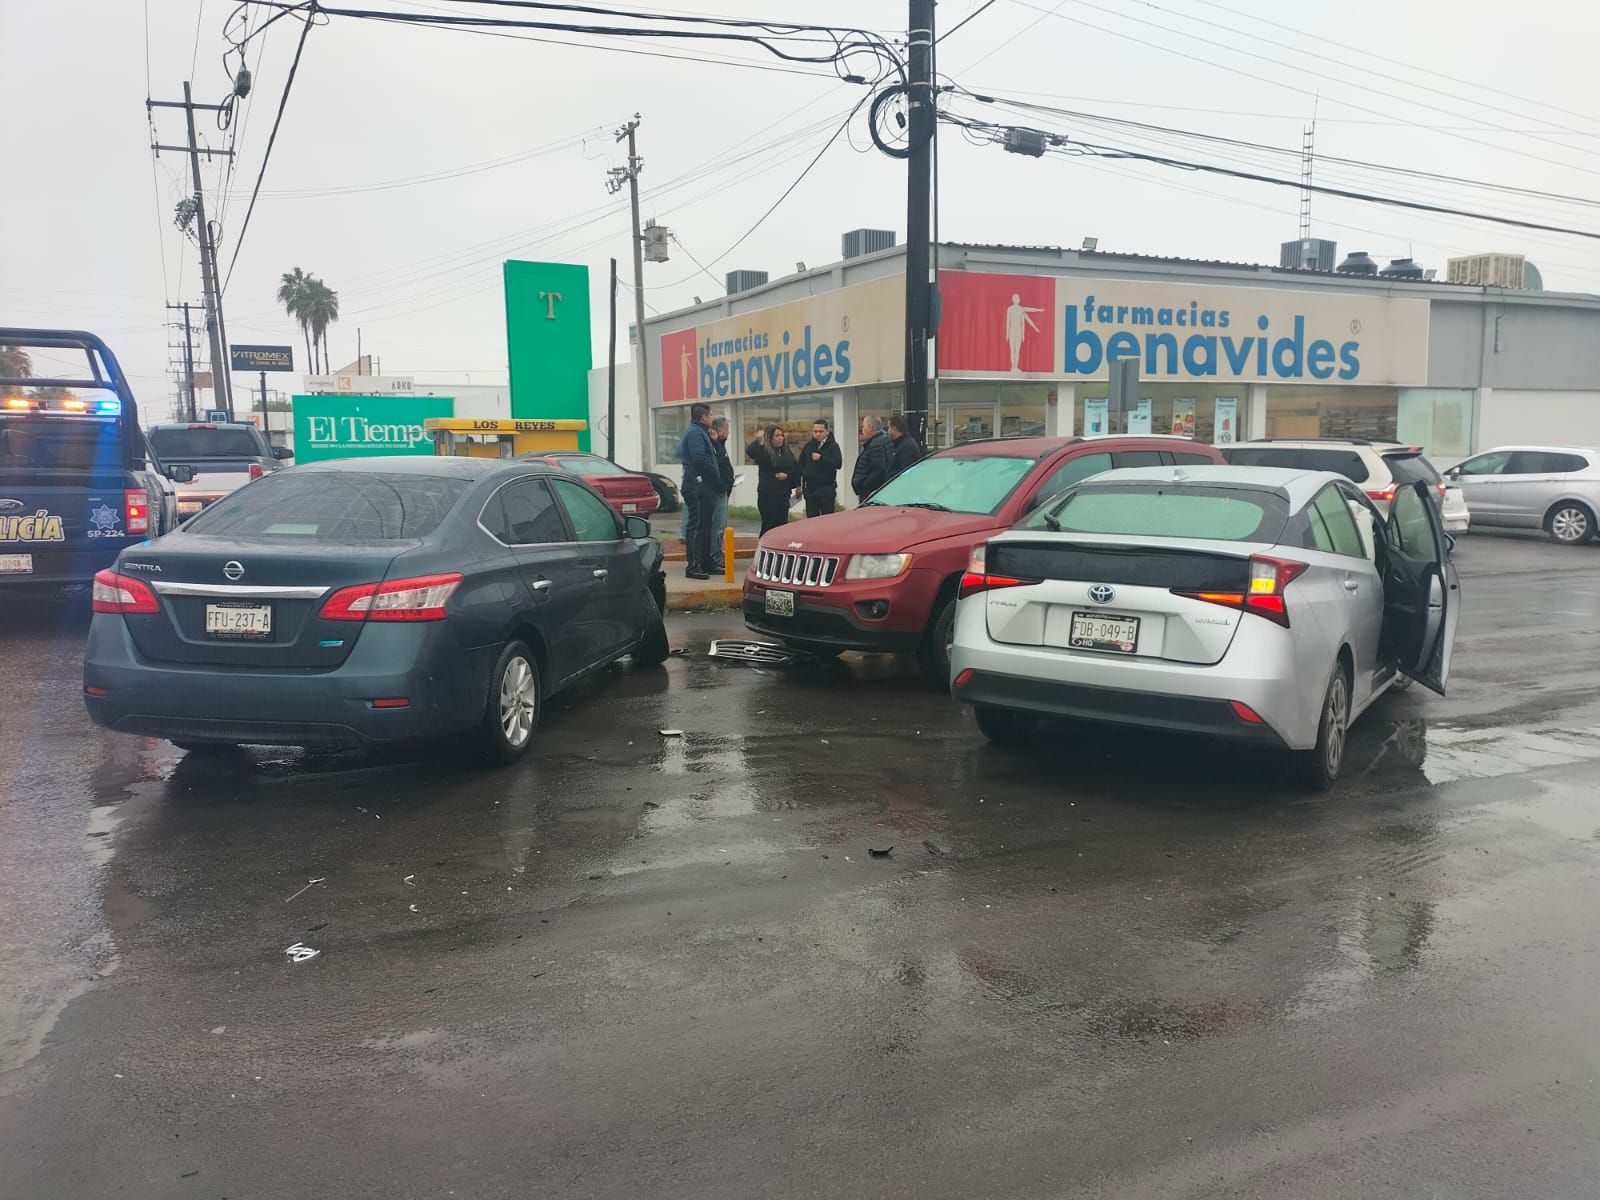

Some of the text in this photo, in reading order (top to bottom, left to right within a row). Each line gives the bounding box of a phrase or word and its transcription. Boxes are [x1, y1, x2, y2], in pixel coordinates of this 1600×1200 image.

[539, 291, 562, 320] T
[1084, 296, 1230, 328] farmacias
[706, 328, 769, 358] farmacias
[1064, 304, 1360, 380] benavides
[231, 351, 289, 360] VITROMEX
[700, 324, 851, 398] benavides
[306, 416, 338, 442] El
[473, 421, 555, 430] LOS REYES
[87, 529, 124, 537] SP-224
[124, 562, 162, 572] SENTRA
[208, 611, 269, 628] FFU-237-A
[1073, 620, 1135, 640] FDB-049-B
